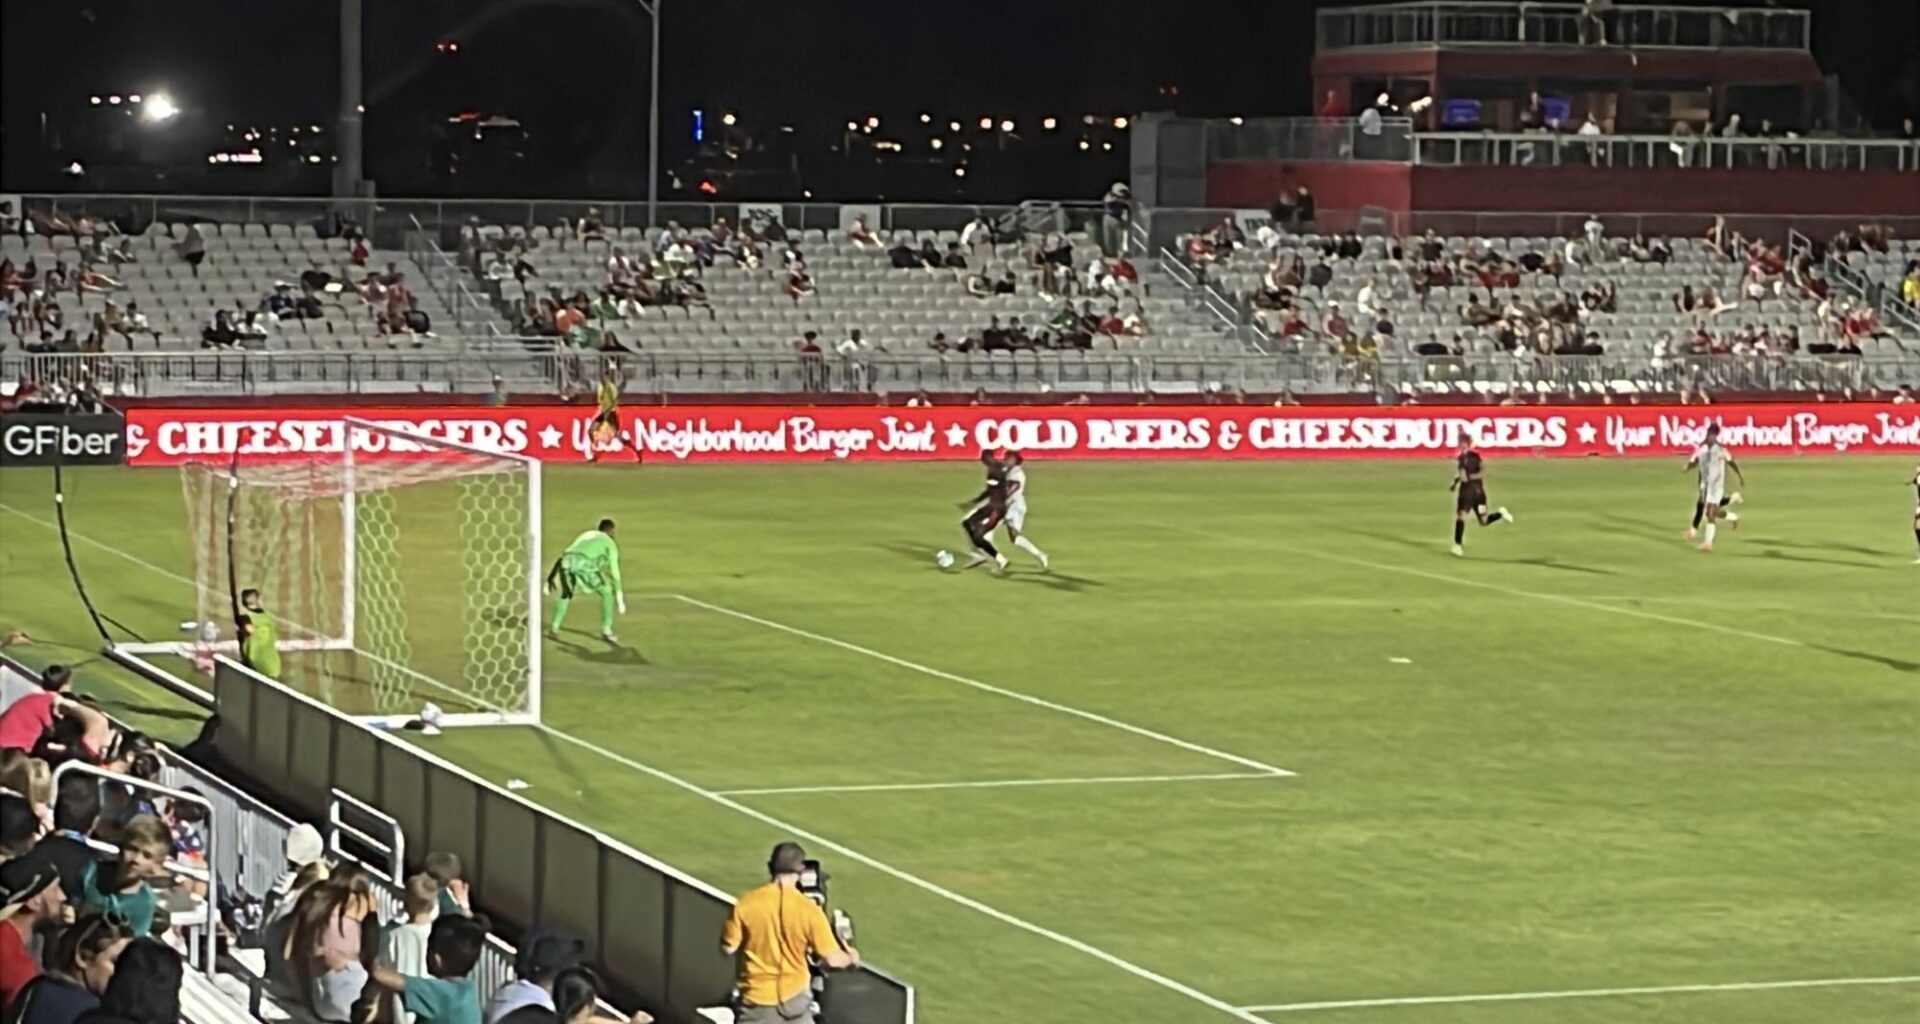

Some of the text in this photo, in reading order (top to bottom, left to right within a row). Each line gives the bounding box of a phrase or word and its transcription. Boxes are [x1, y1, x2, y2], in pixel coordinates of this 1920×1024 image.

[572, 418, 630, 460] Yr
[635, 417, 786, 459] Neighborhood
[788, 416, 873, 458] Burger
[877, 416, 936, 452] Joint
[975, 419, 1079, 450] COLD
[1086, 418, 1210, 449] BEERS
[1217, 420, 1242, 450] &
[1249, 417, 1567, 449] CHEESEBURGERS
[1606, 415, 1656, 454] Your
[1794, 412, 1869, 451] Burger
[1871, 411, 1920, 445] Joint
